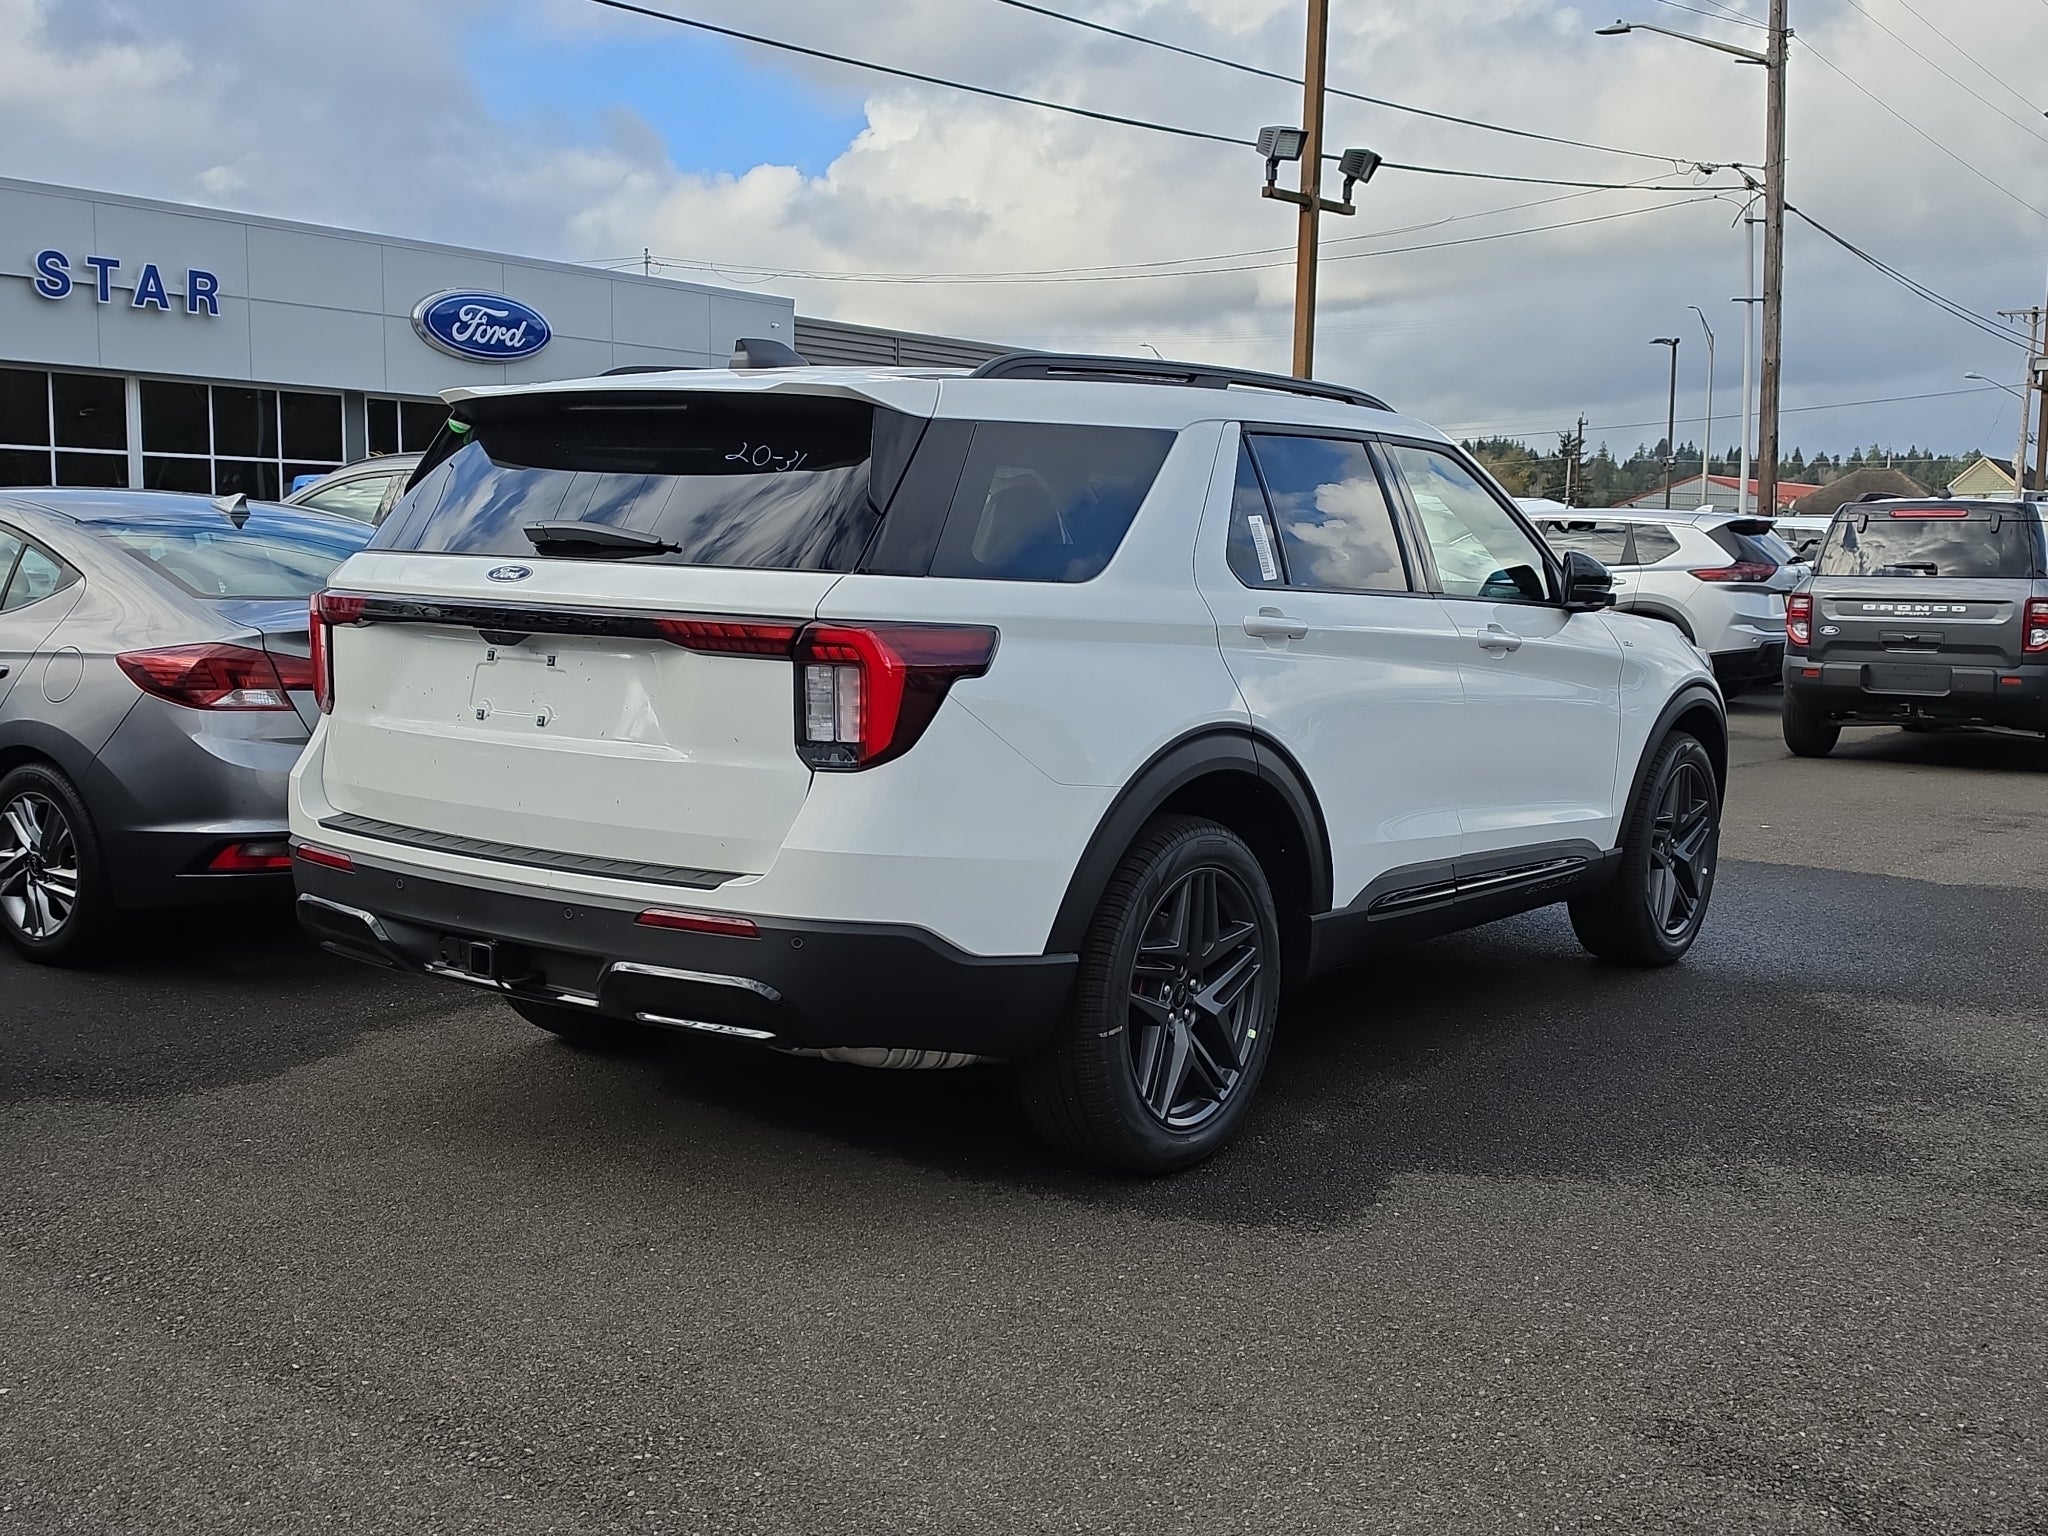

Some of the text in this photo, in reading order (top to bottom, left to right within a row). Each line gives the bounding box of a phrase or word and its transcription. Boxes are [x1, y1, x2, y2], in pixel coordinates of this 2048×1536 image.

[34, 249, 221, 317] STAR
[452, 304, 527, 348] Ford
[1862, 603, 1967, 613] BRONCO
